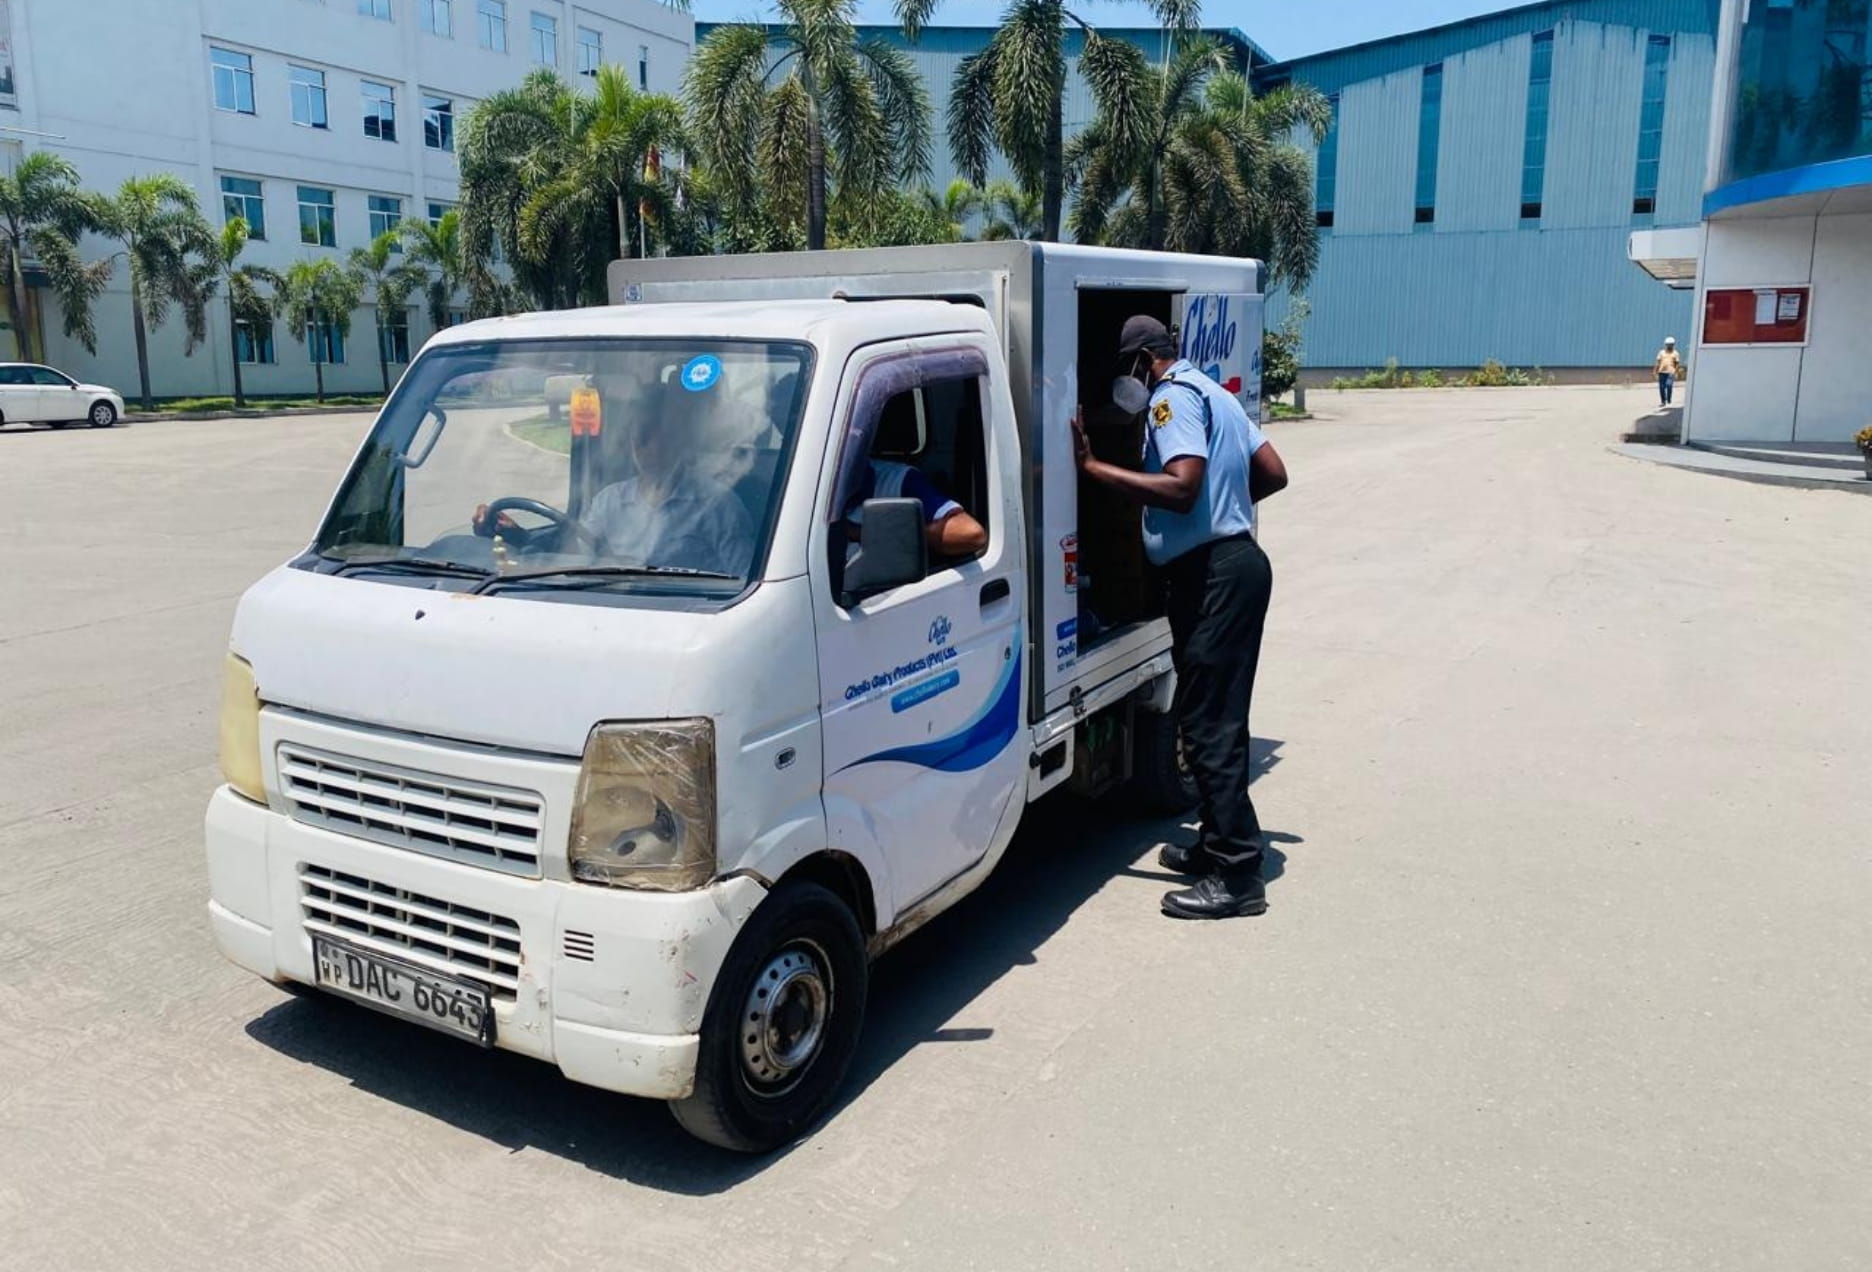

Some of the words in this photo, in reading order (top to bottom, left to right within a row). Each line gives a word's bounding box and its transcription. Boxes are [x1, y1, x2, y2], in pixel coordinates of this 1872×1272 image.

[1181, 296, 1237, 369] Chello
[894, 658, 926, 680] Products
[346, 954, 400, 1001] DAC
